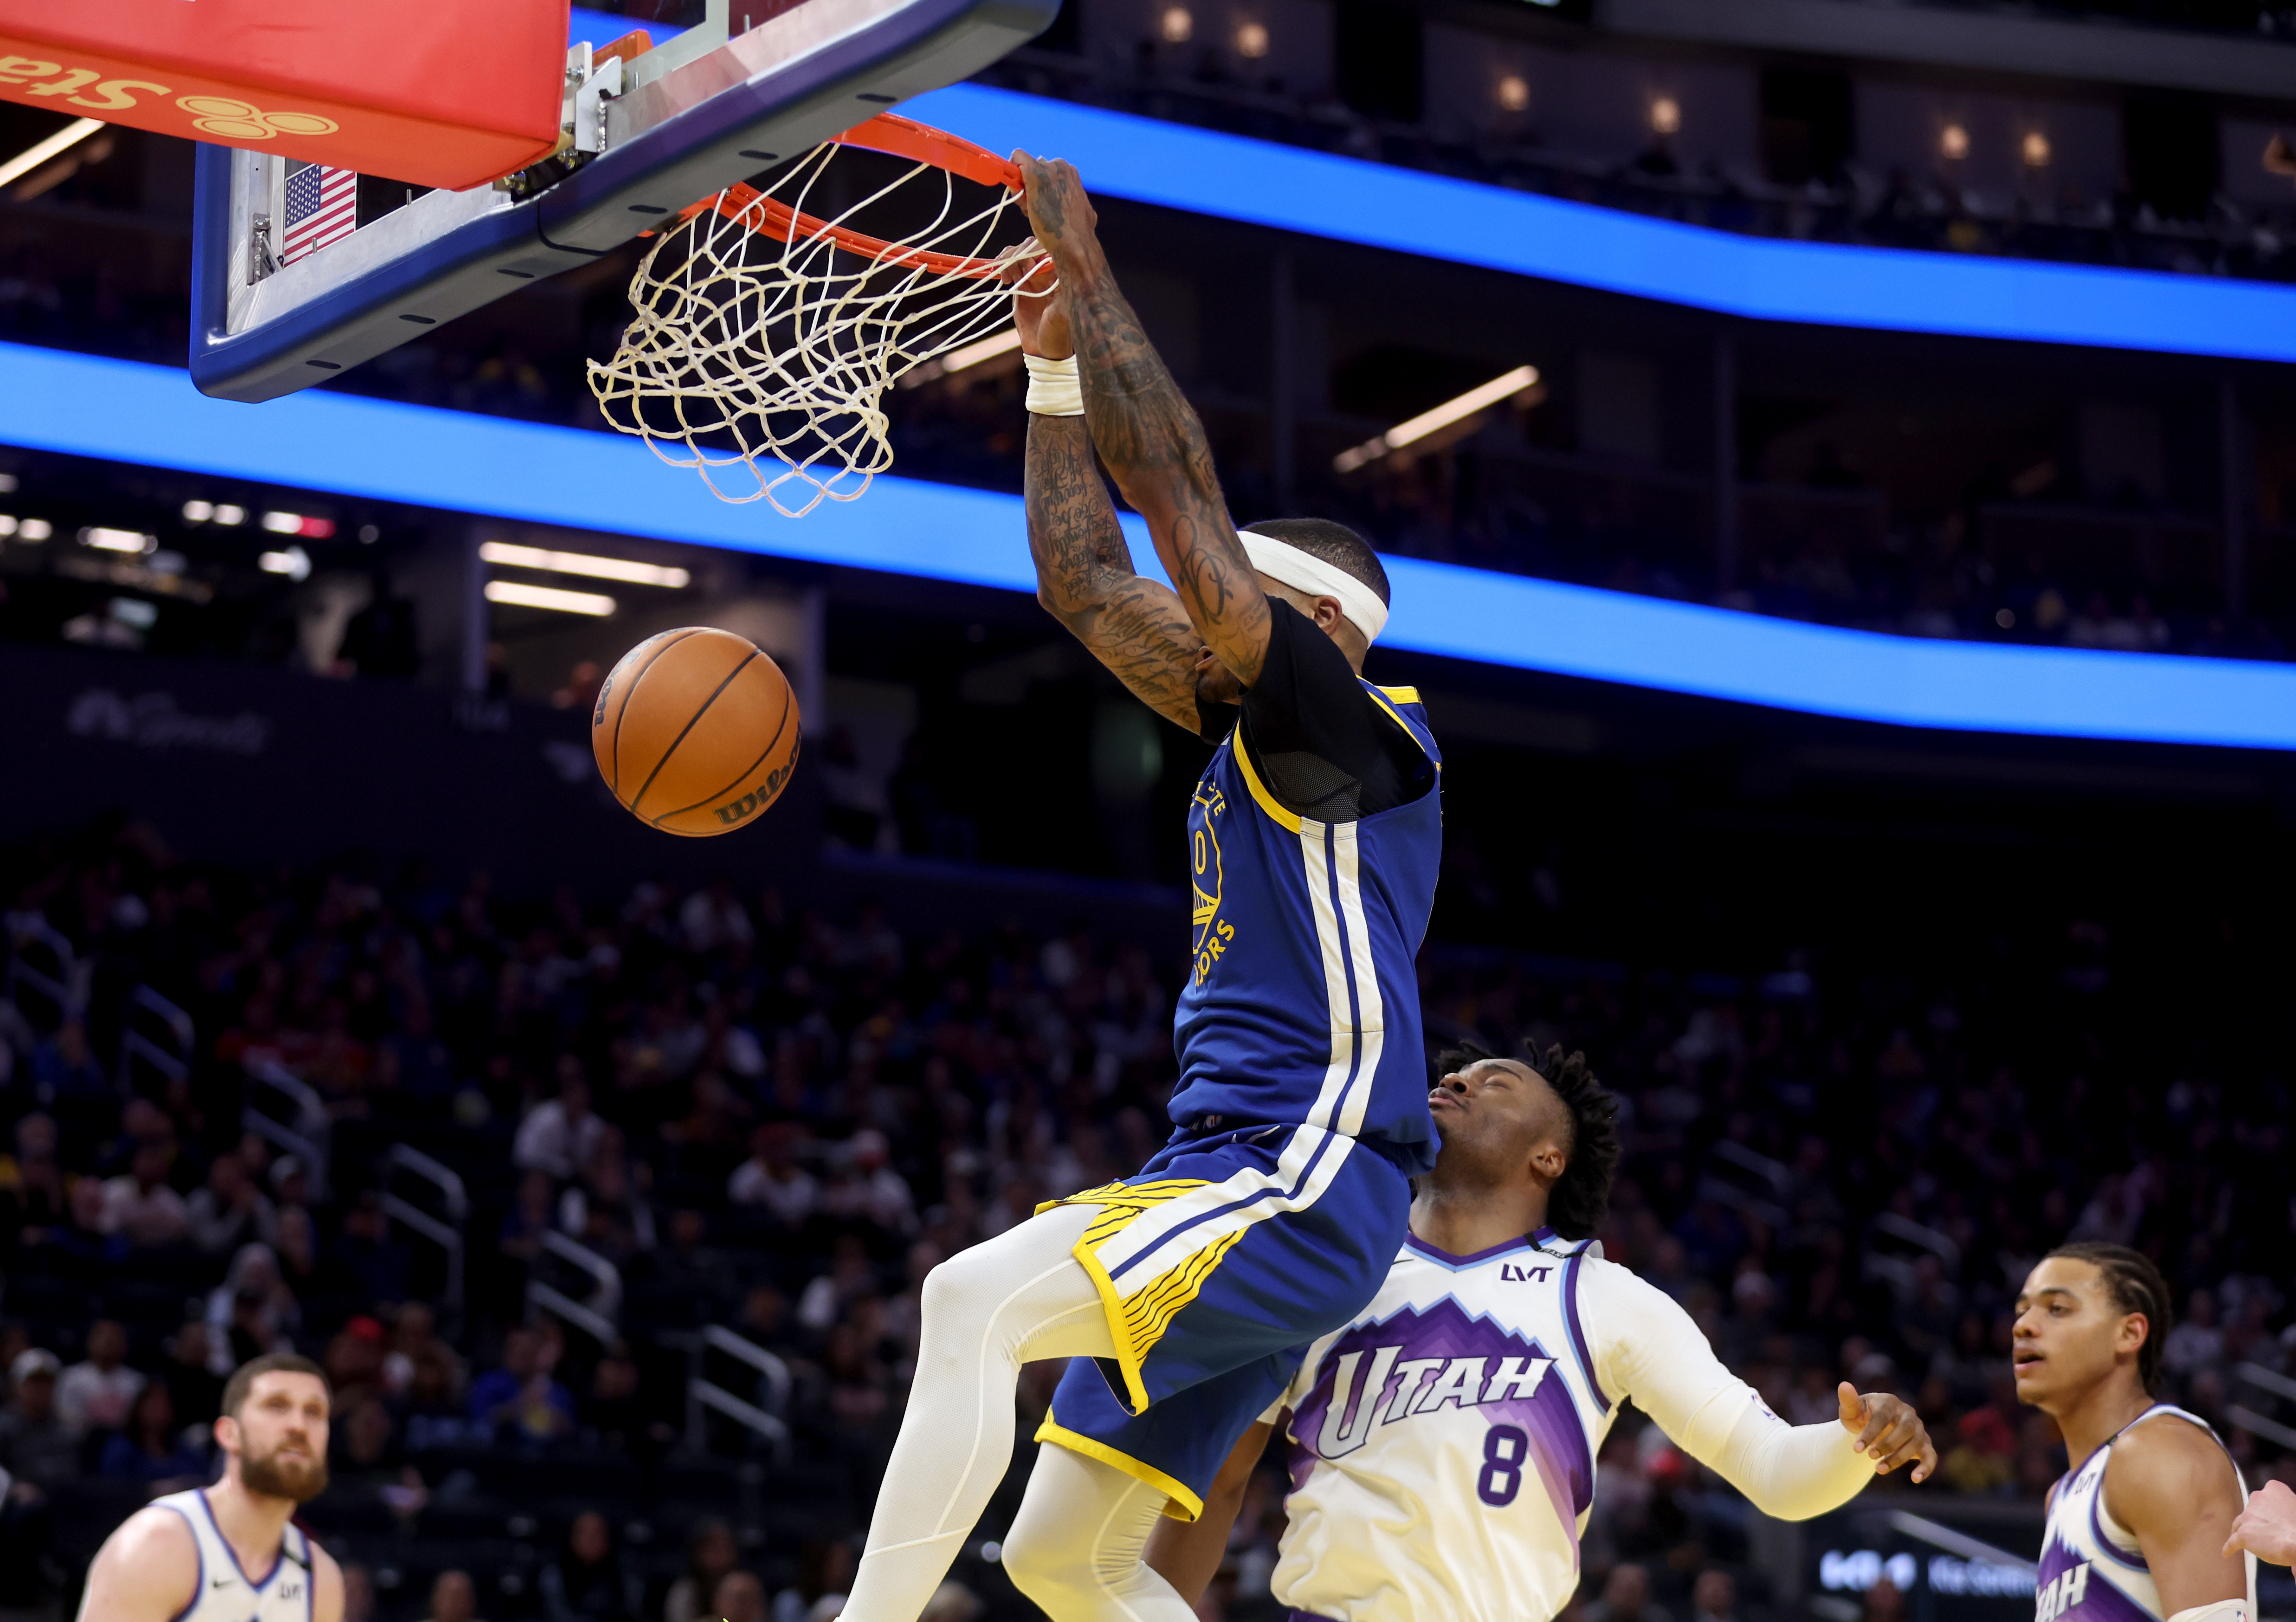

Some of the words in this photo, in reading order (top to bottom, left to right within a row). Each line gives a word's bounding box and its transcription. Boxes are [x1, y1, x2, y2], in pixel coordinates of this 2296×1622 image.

[1195, 830, 1206, 875] 0
[1500, 1263, 1554, 1282] LVT
[1317, 1345, 1558, 1460] UTAH
[1477, 1424, 1528, 1508] 8
[2035, 1558, 2093, 1622] AH
